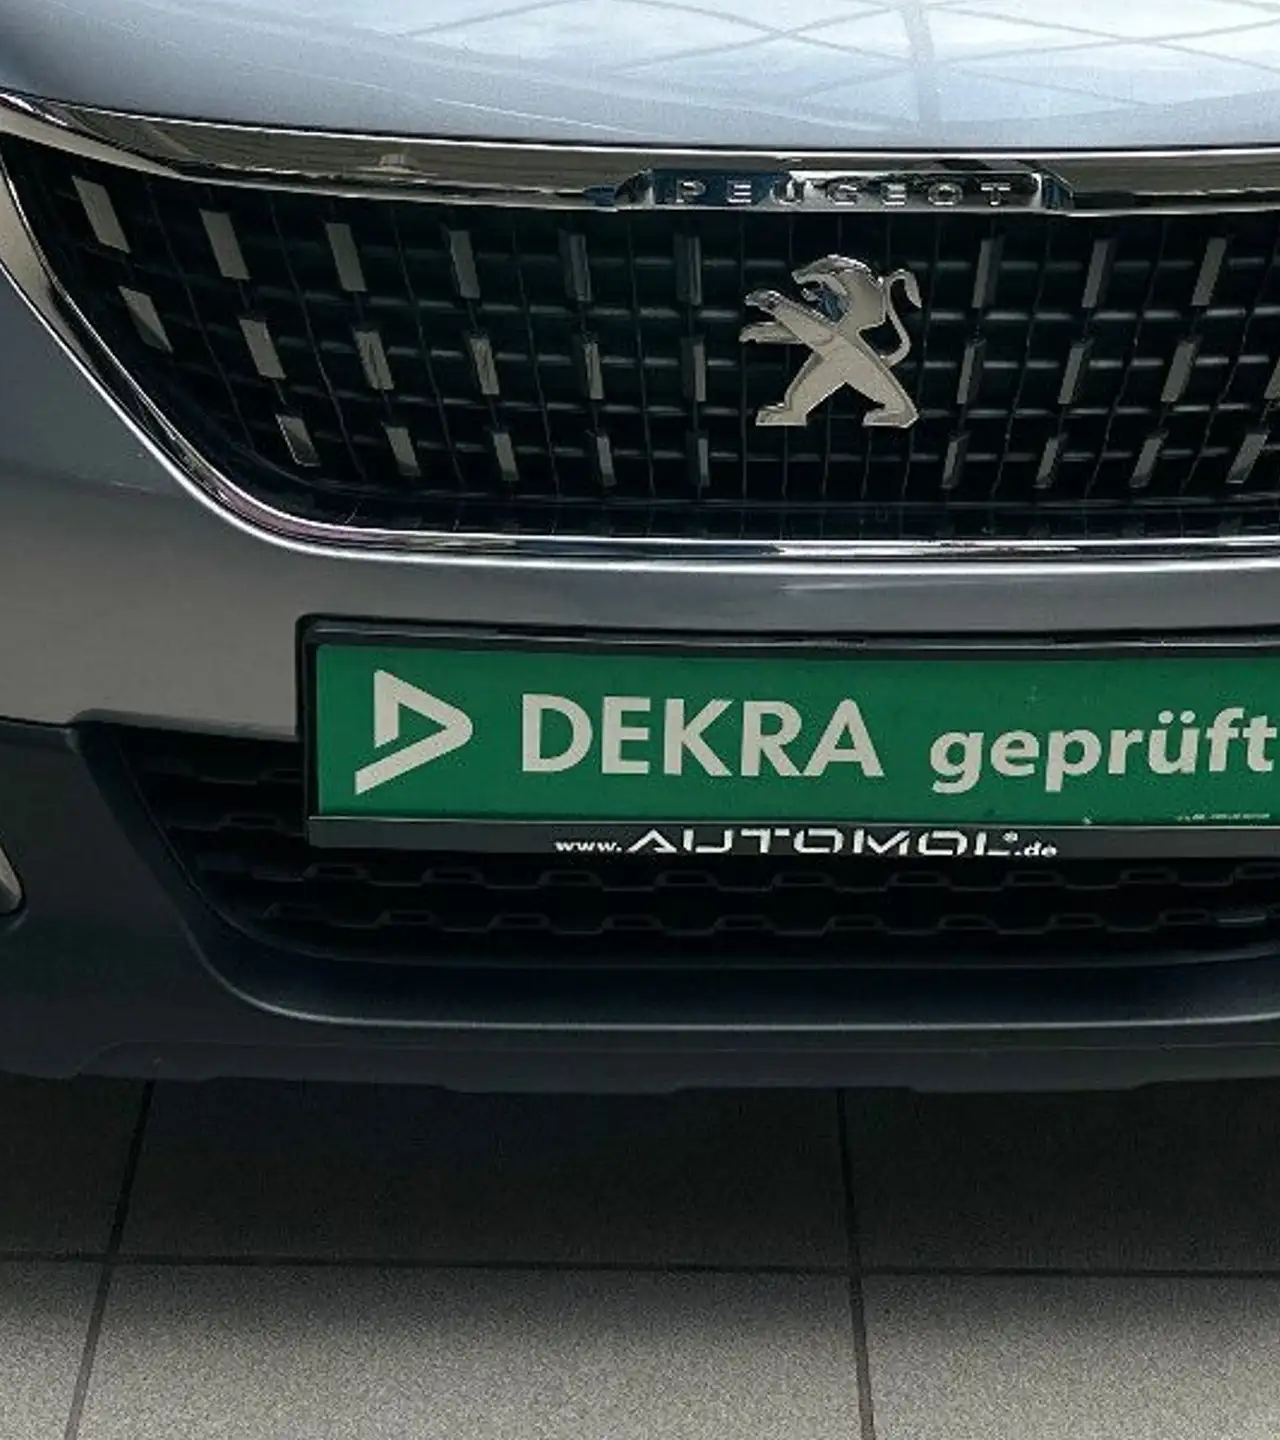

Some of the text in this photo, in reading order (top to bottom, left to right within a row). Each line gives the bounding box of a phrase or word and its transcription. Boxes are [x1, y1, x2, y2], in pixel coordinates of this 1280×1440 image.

[674, 178, 1011, 206] PEUGEOT
[521, 693, 1278, 794] DEKRA geprüft
